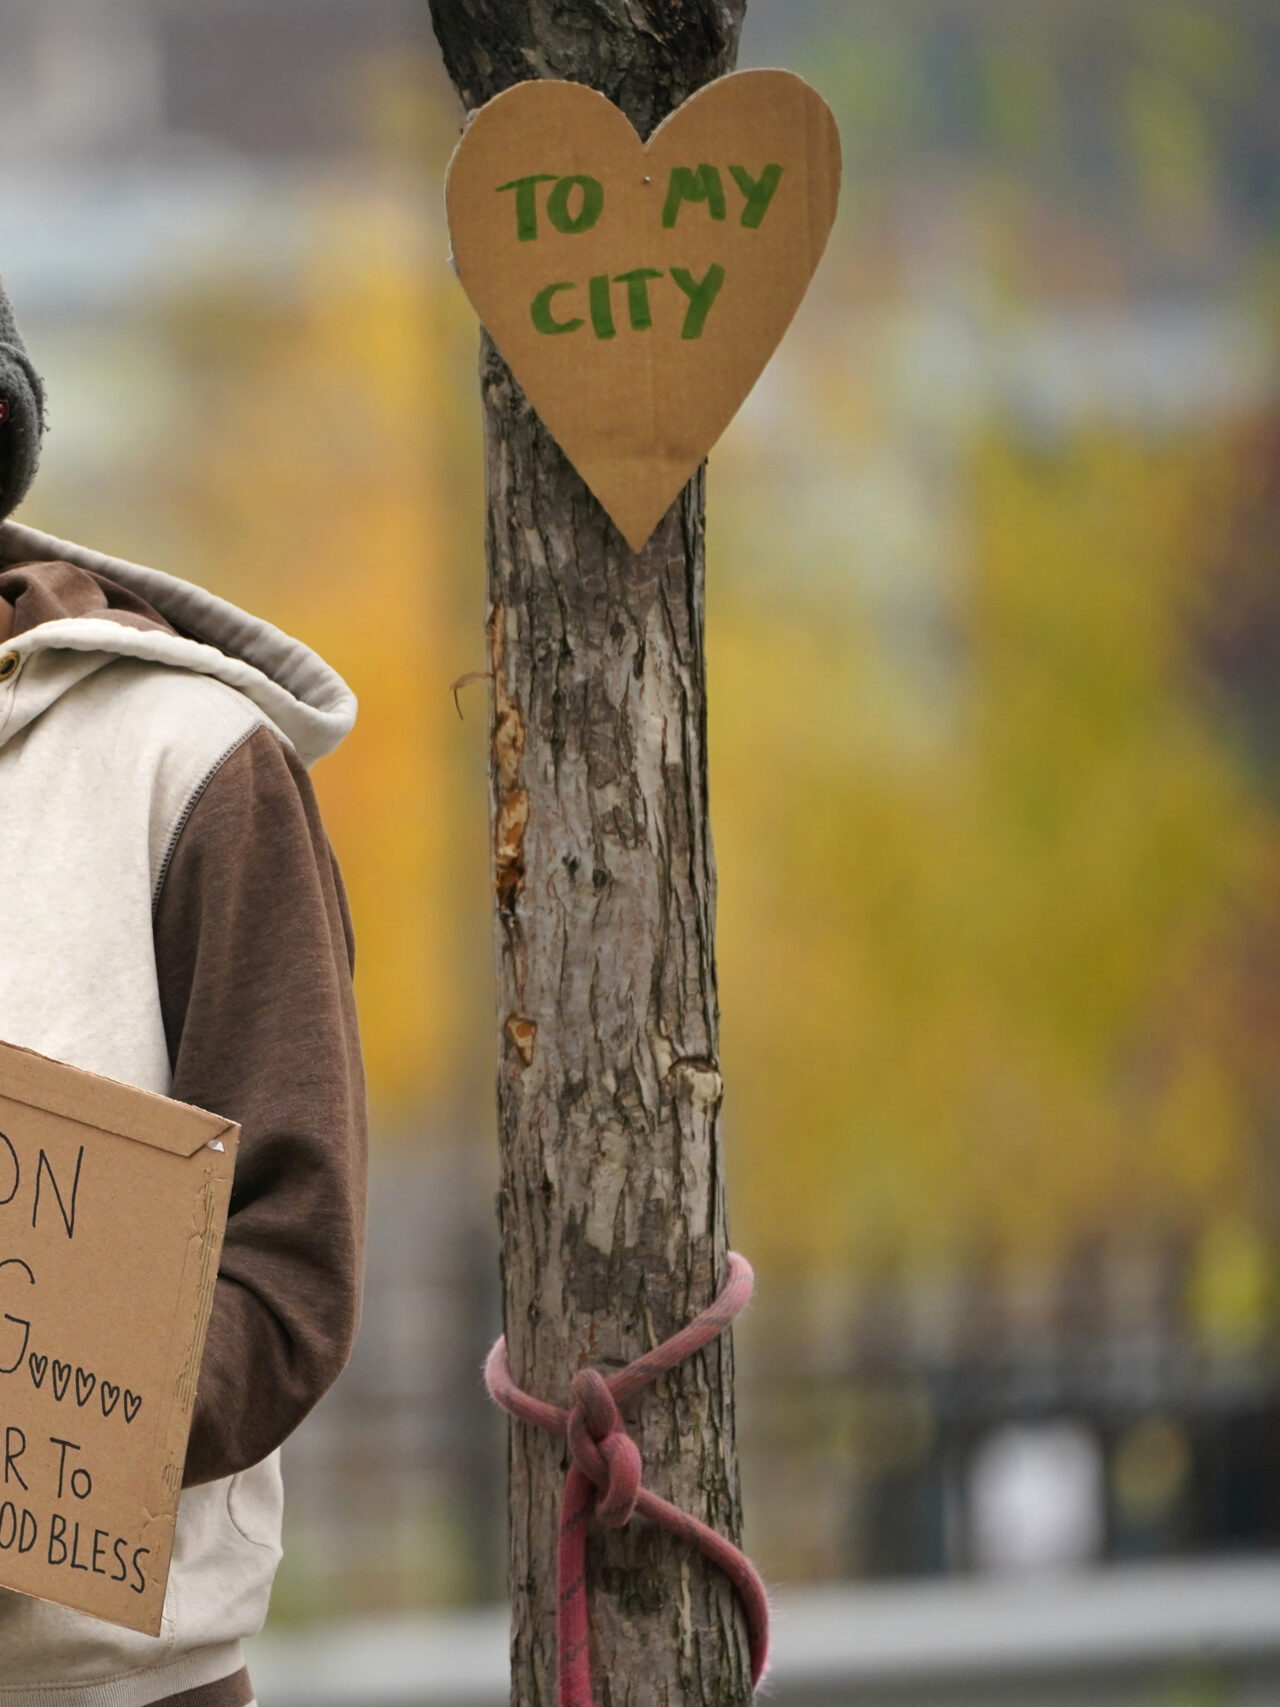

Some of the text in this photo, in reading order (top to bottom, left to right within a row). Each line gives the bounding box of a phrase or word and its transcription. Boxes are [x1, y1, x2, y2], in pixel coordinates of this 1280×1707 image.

[495, 163, 784, 242] TO MY
[530, 262, 726, 340] CITY
[49, 1514, 150, 1593] BLESS
